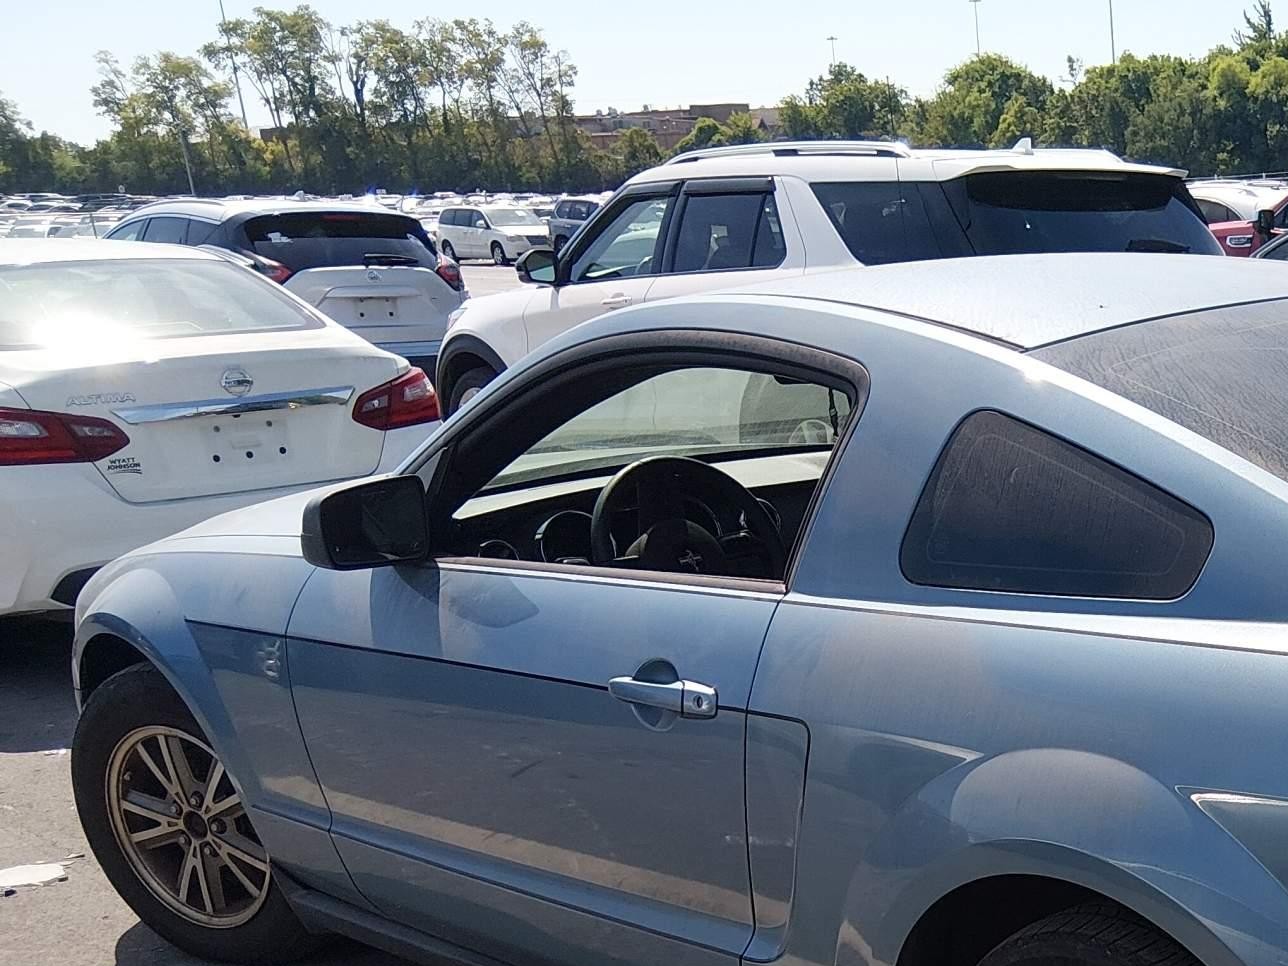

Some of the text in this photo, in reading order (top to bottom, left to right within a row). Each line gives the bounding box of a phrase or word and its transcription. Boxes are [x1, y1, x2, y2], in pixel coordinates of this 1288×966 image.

[66, 392, 137, 407] ALTIMA
[109, 457, 135, 465] WYATT
[107, 462, 141, 470] JOHNSON
